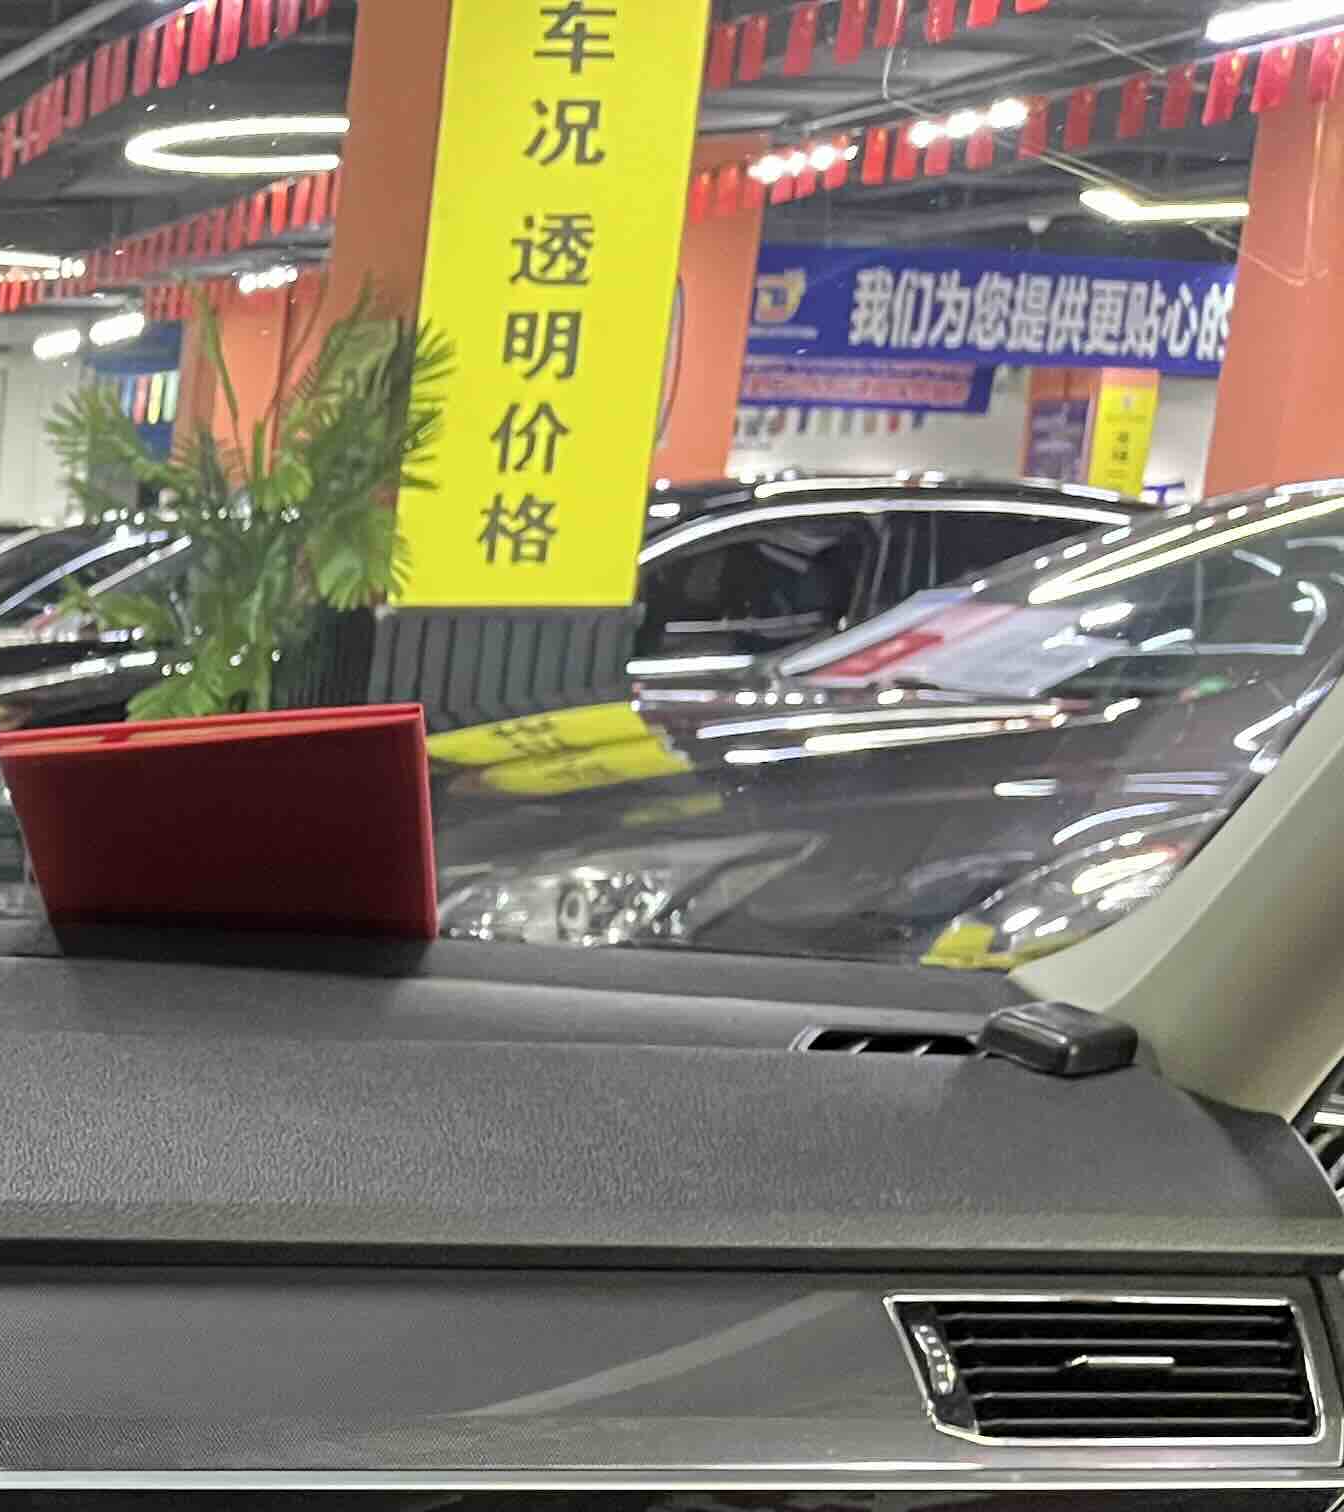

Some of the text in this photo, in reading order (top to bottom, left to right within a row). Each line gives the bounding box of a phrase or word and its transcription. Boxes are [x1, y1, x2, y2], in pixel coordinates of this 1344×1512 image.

[476, 0, 617, 566] 车况透明价格
